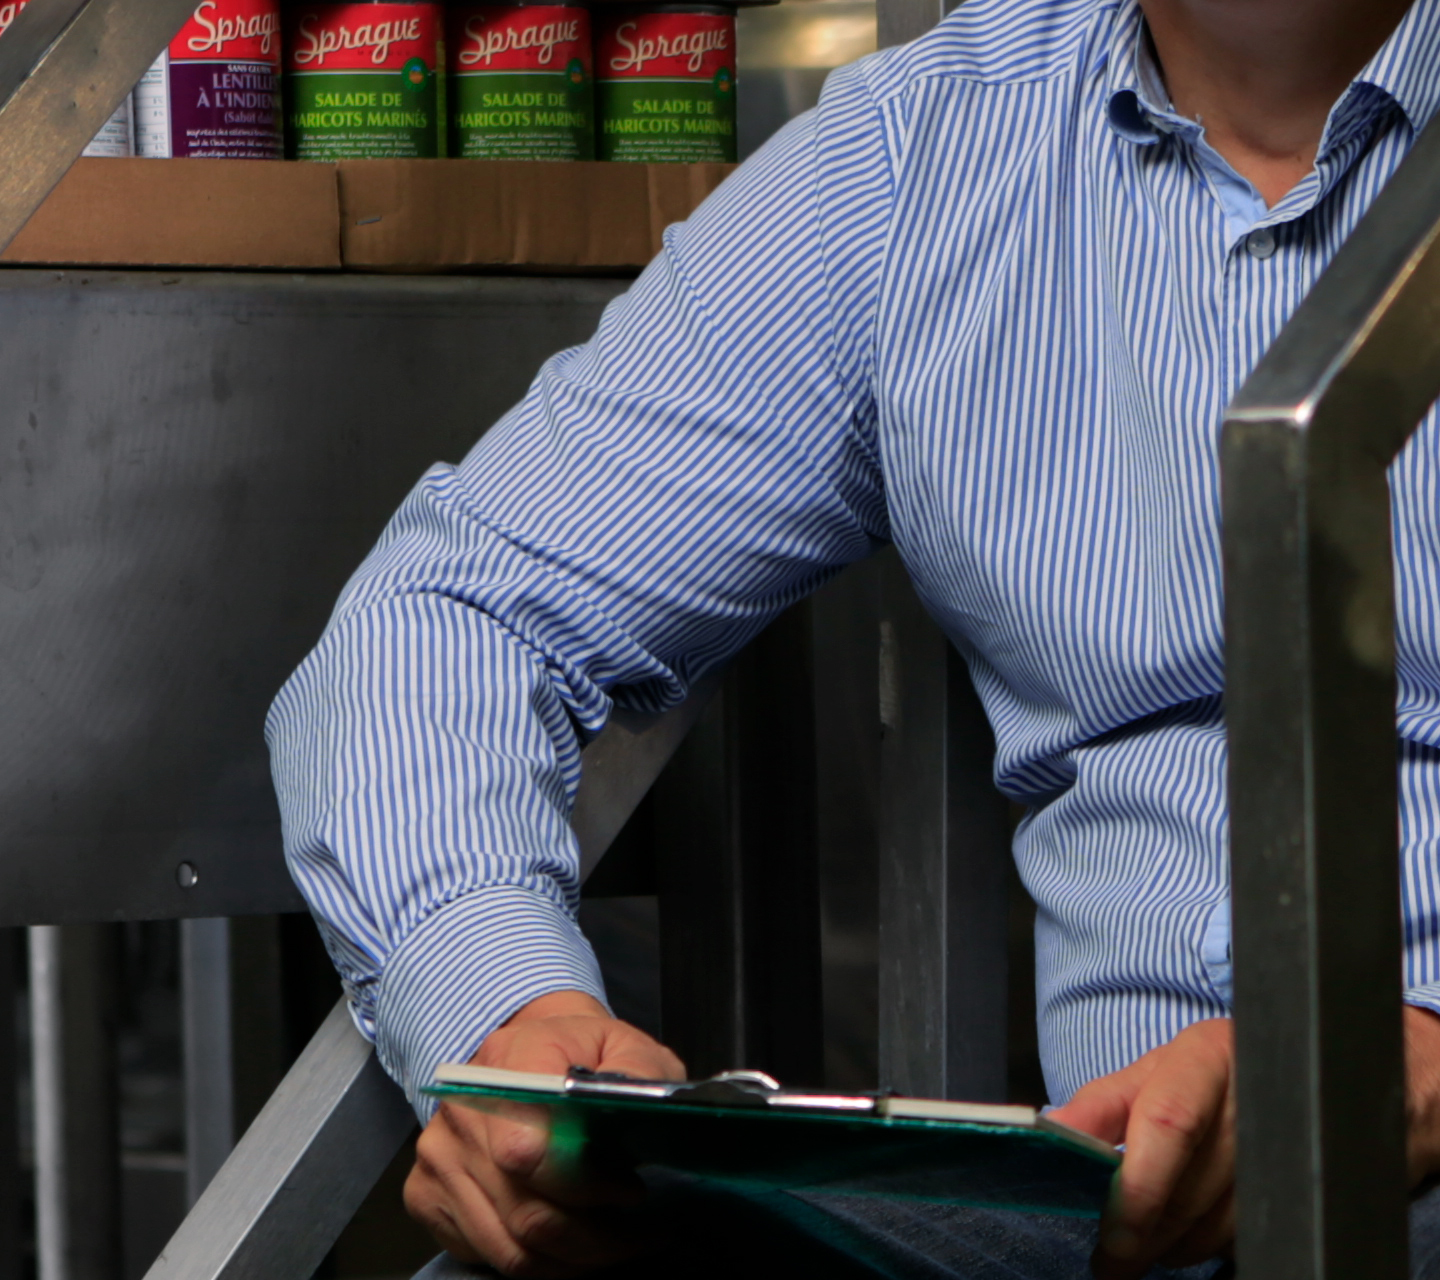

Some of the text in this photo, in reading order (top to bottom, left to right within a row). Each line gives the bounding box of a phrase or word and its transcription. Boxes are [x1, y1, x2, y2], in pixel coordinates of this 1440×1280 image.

[294, 14, 420, 64] Sprague
[459, 15, 579, 65] Sprague
[610, 22, 727, 72] Sprague
[197, 87, 210, 108] À
[315, 93, 402, 108] SALADE DE
[483, 93, 567, 108] SALADE DE
[632, 99, 715, 114] SALADE DE
[367, 109, 427, 128] MARINÉS
[604, 118, 680, 134] HARICOTS
